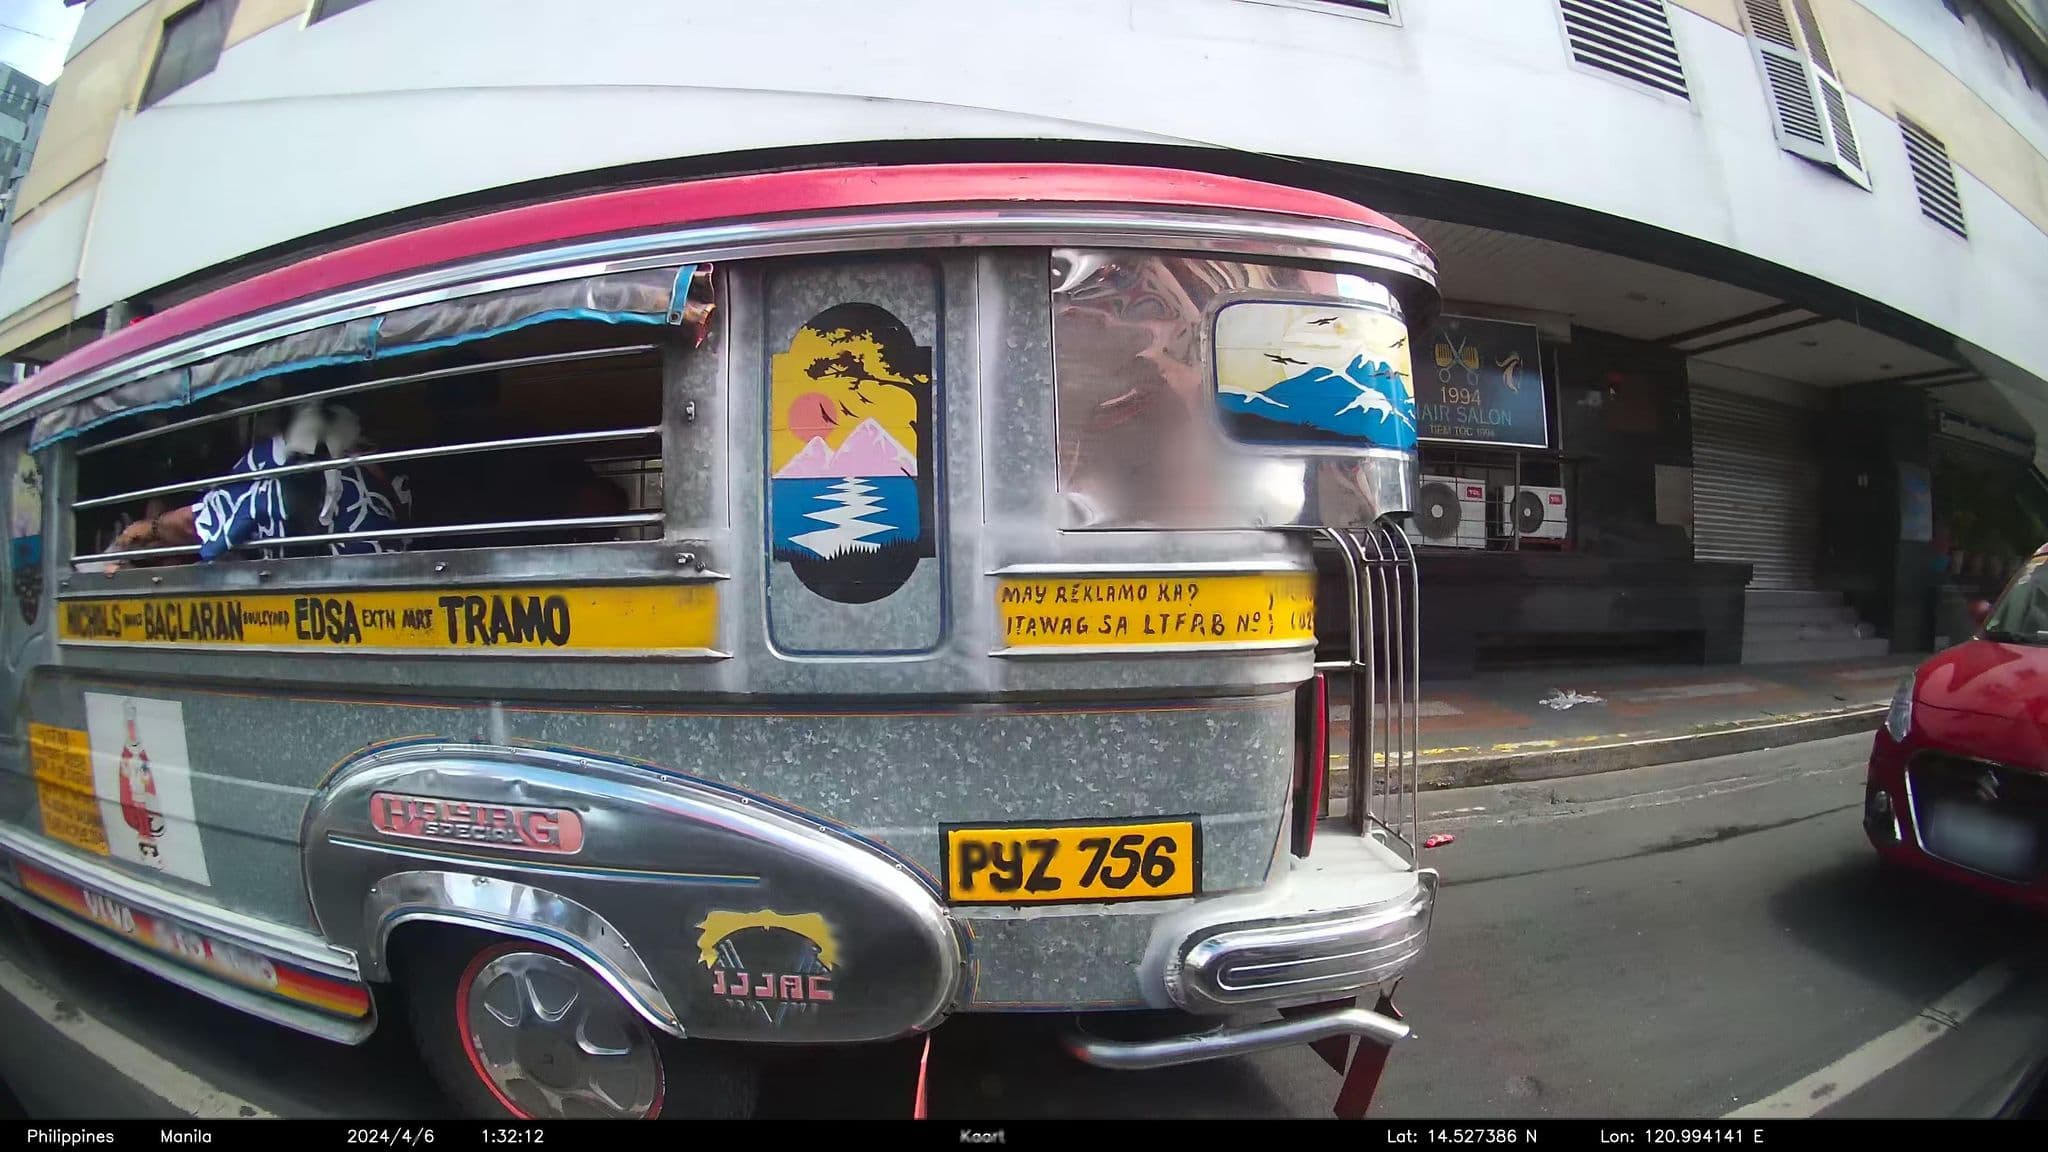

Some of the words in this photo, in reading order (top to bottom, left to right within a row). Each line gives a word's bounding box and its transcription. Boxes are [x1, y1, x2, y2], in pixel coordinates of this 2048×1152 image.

[1441, 386, 1480, 405] 1994
[1456, 405, 1512, 426] SALON
[1001, 586, 1047, 604] MAY
[1055, 584, 1147, 603] REKLAMO
[1157, 583, 1199, 606] KA?
[144, 601, 243, 641] BACLARAN
[295, 597, 362, 643] EDSA
[362, 609, 395, 629] EXTN
[438, 594, 571, 646] TRAMO
[1006, 615, 1089, 636] ITAWAG
[1099, 614, 1127, 636] SA
[1144, 613, 1226, 636] LTFRB
[426, 822, 524, 843] SPECIAL
[957, 838, 1062, 892] PYZ
[1077, 834, 1178, 889] 756
